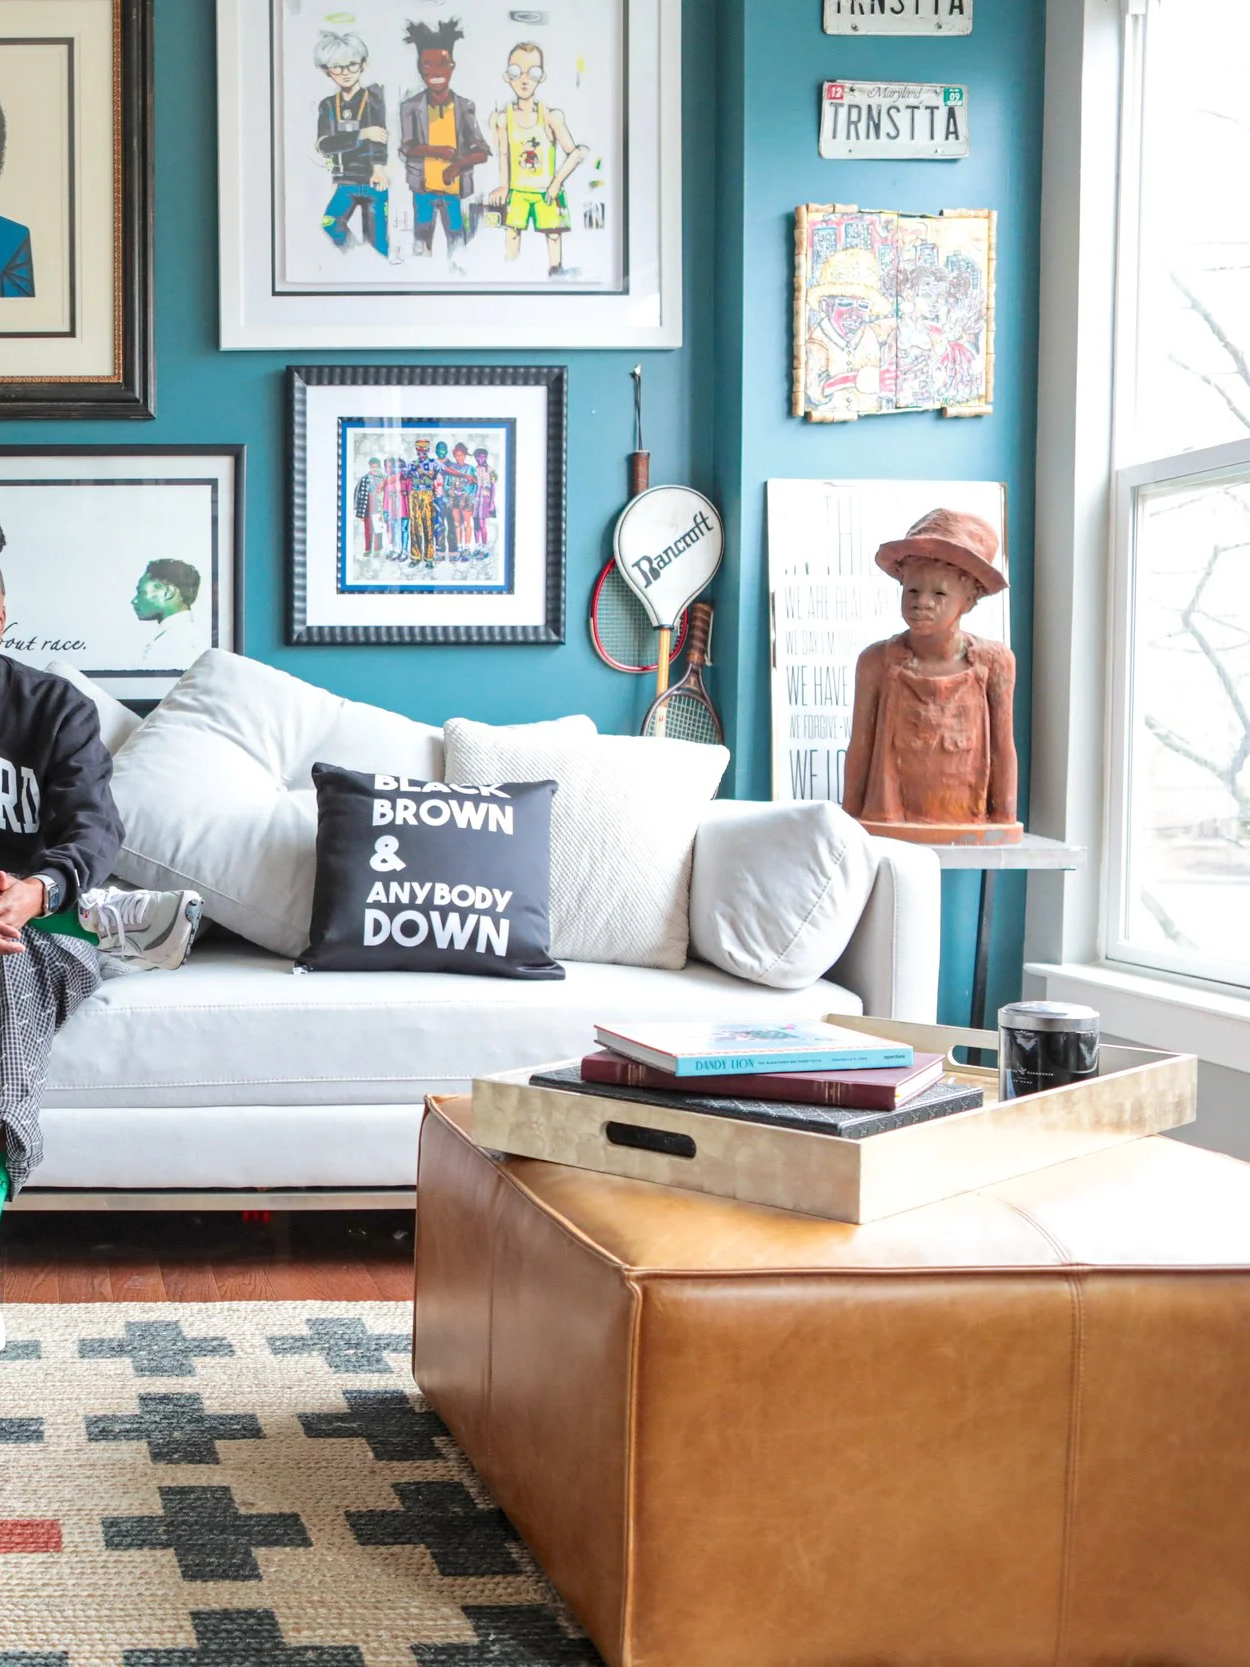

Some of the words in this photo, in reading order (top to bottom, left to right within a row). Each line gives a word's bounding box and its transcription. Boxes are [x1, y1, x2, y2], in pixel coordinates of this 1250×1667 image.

[830, 87, 844, 98] 12
[867, 86, 922, 103] Maryland
[949, 92, 960, 102] 09
[829, 102, 960, 141] TRNSTTA
[631, 511, 714, 589] Bancroft
[784, 585, 802, 620] WE
[40, 637, 87, 651] race.
[785, 630, 798, 656] WE
[821, 630, 836, 656] IM
[786, 665, 808, 706] WE
[813, 665, 850, 707] HAVE
[789, 715, 800, 740] WE
[803, 715, 838, 740] FORGIVE
[374, 774, 511, 799] BLACK
[789, 749, 818, 801] WE
[372, 798, 514, 836] BROWN
[369, 835, 407, 872] &
[366, 881, 513, 913] ANYBODY
[363, 908, 510, 957] DOWN
[695, 1059, 727, 1071] DANDY
